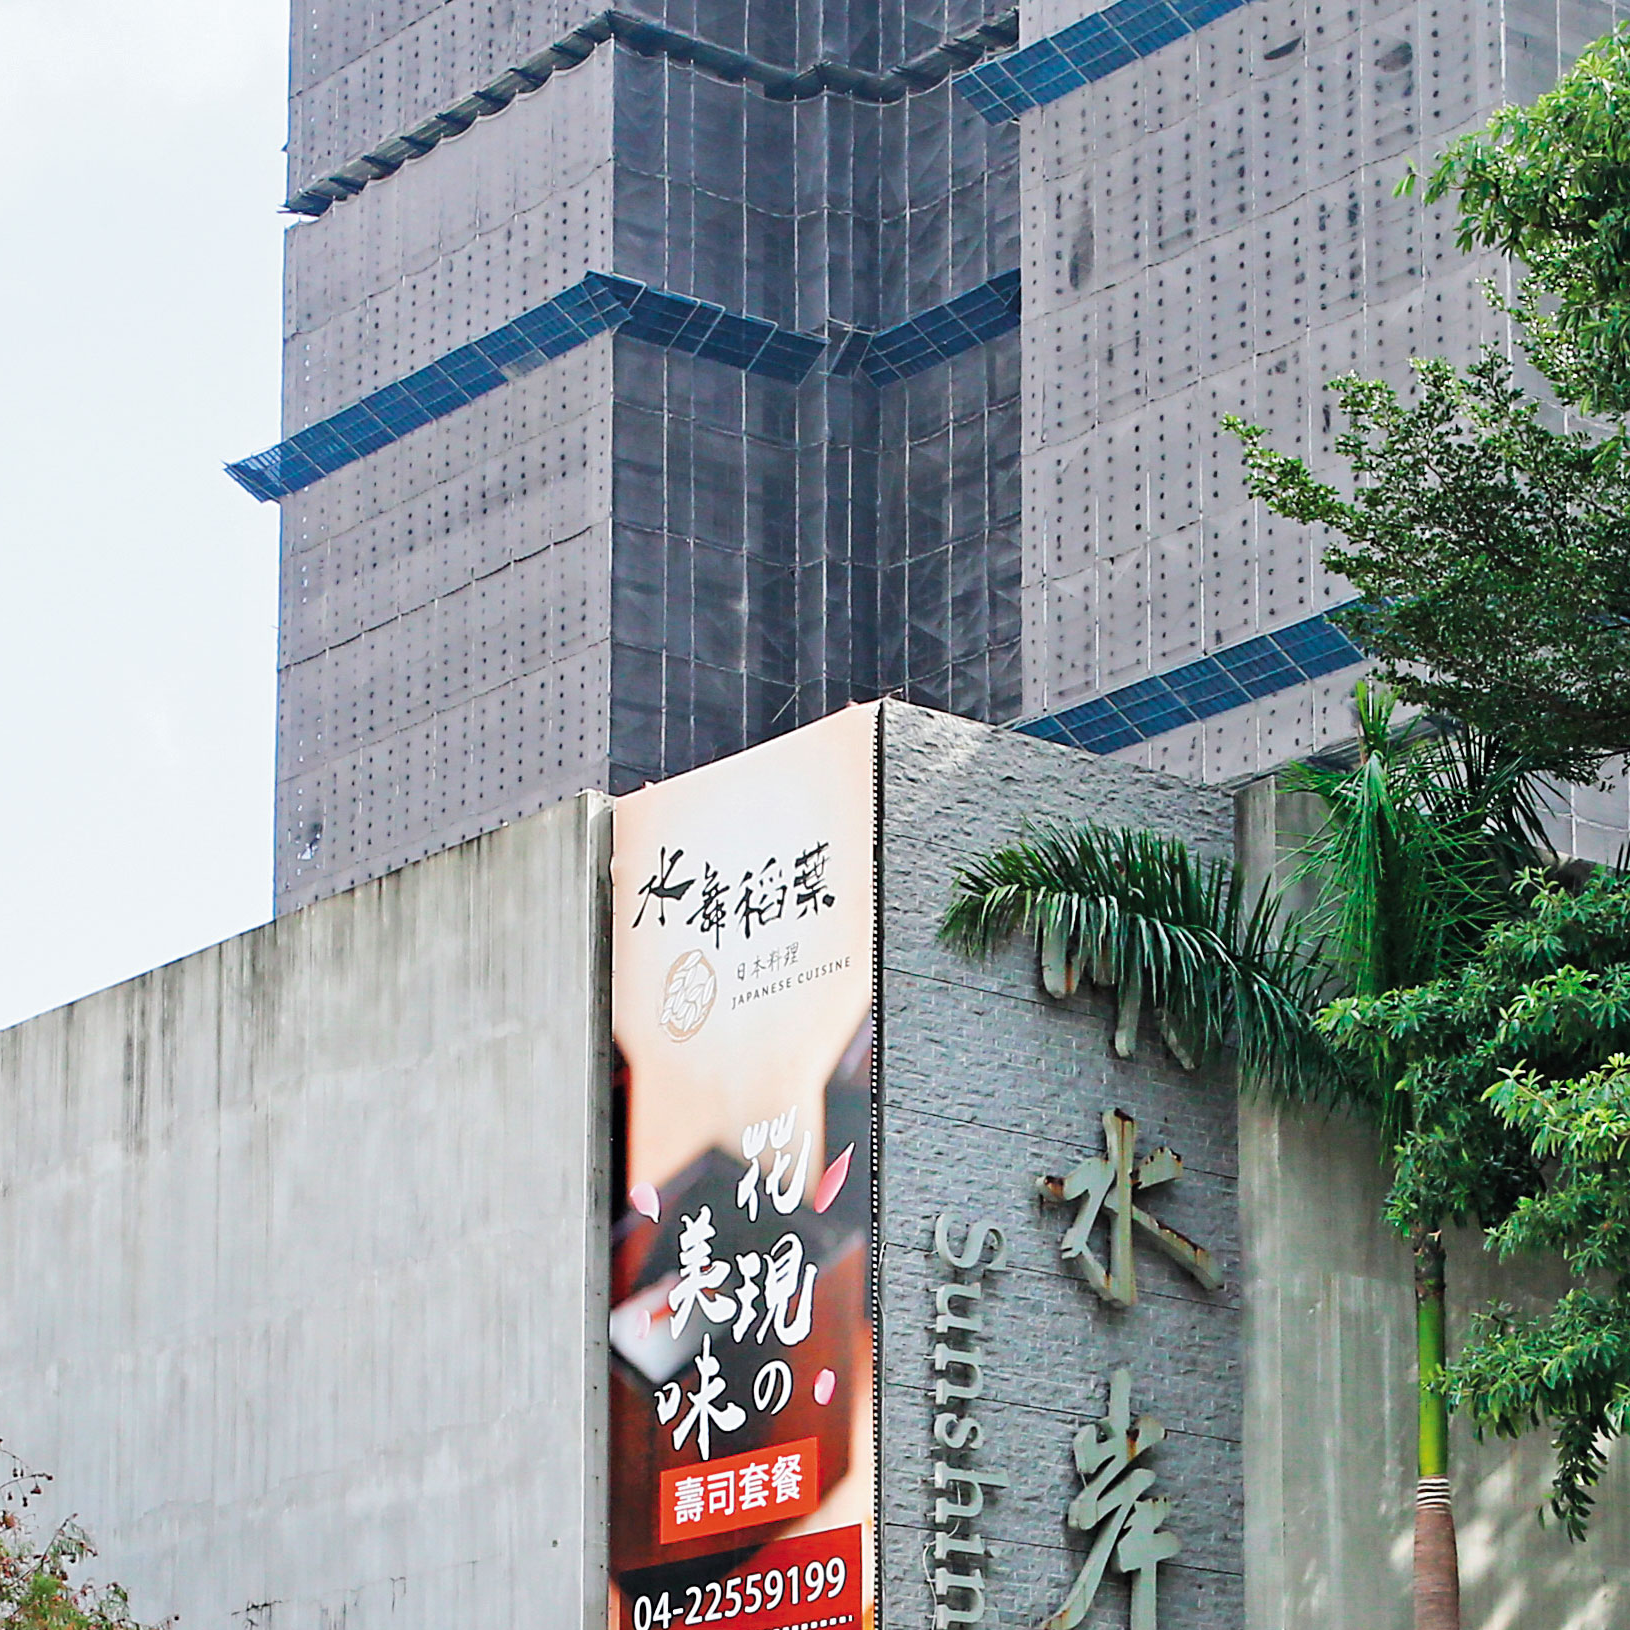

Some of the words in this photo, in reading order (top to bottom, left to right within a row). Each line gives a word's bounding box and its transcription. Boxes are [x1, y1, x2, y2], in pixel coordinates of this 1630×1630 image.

[731, 976, 792, 1010] JAPANESE
[797, 956, 851, 984] CUISINE
[736, 941, 799, 982] 日本料理
[673, 1453, 803, 1525] 壽司套餐
